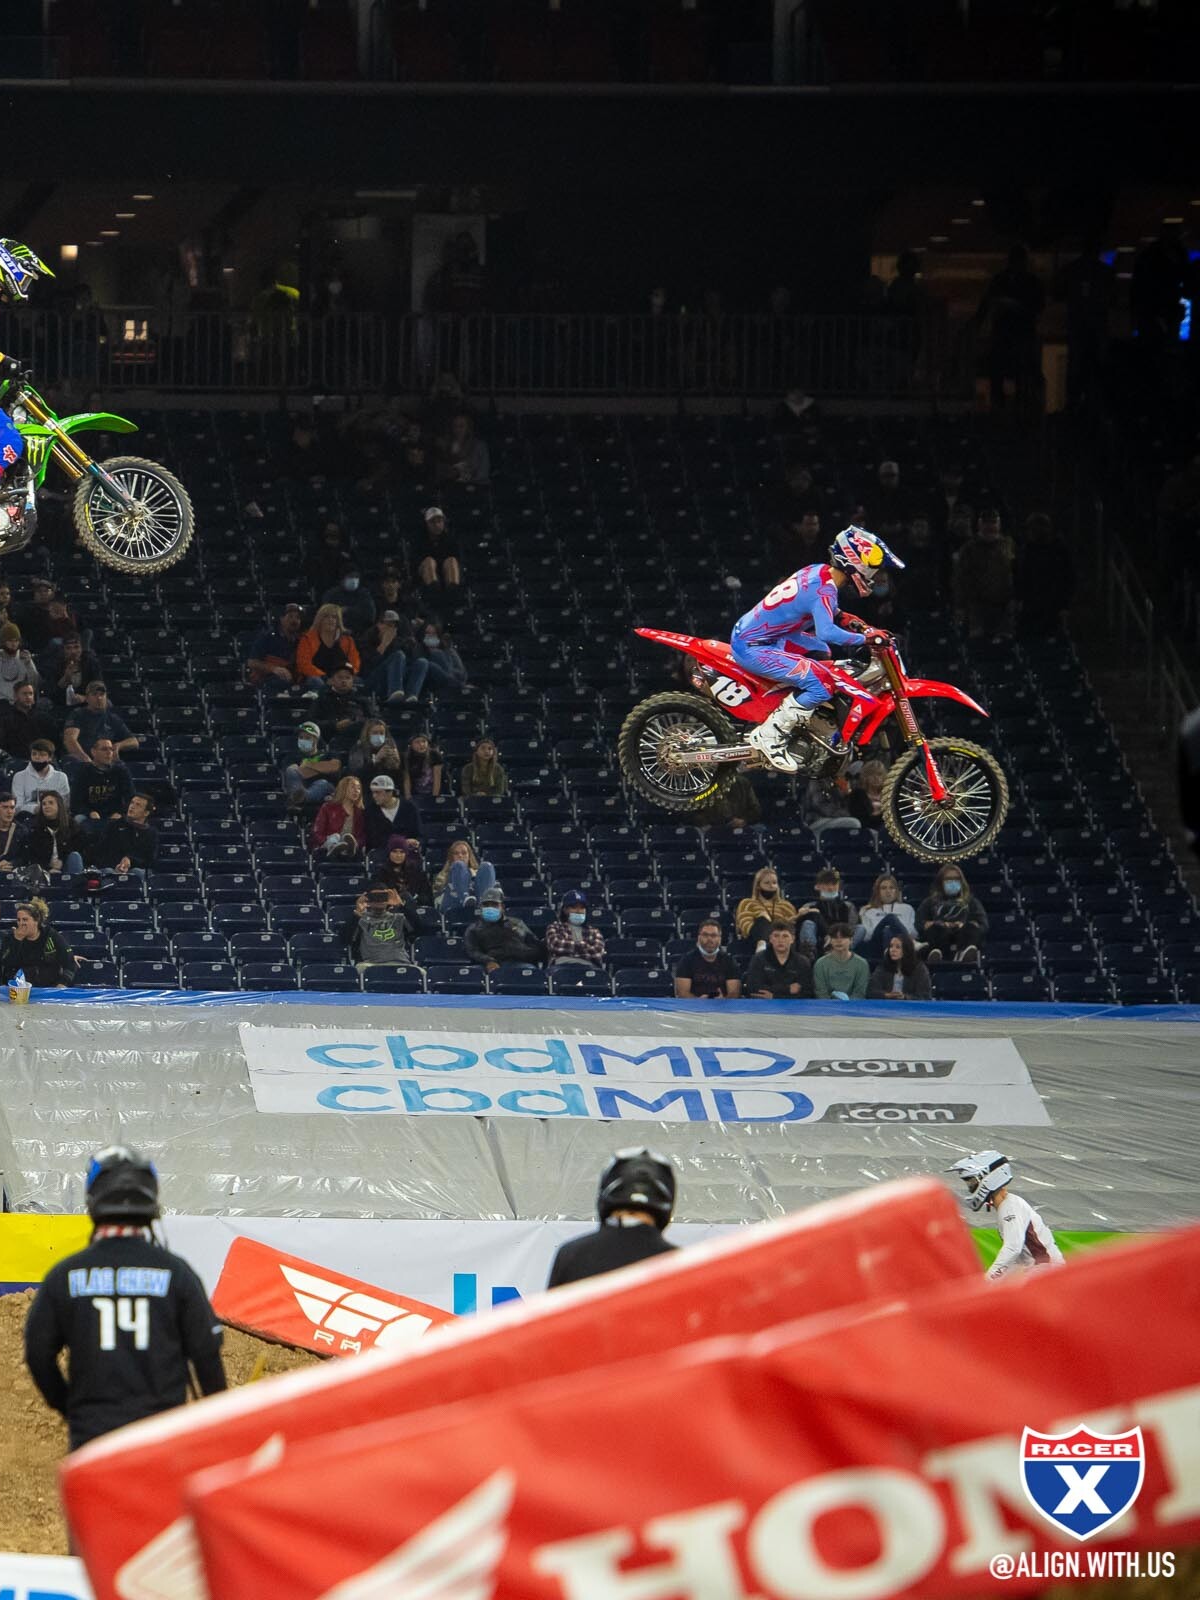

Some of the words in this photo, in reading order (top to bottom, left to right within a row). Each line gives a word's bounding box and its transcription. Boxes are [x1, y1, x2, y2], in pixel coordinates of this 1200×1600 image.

[710, 675, 751, 707] 18
[305, 1035, 796, 1078] cbdMD
[316, 1080, 815, 1123] cbdMD
[92, 1297, 150, 1351] 14
